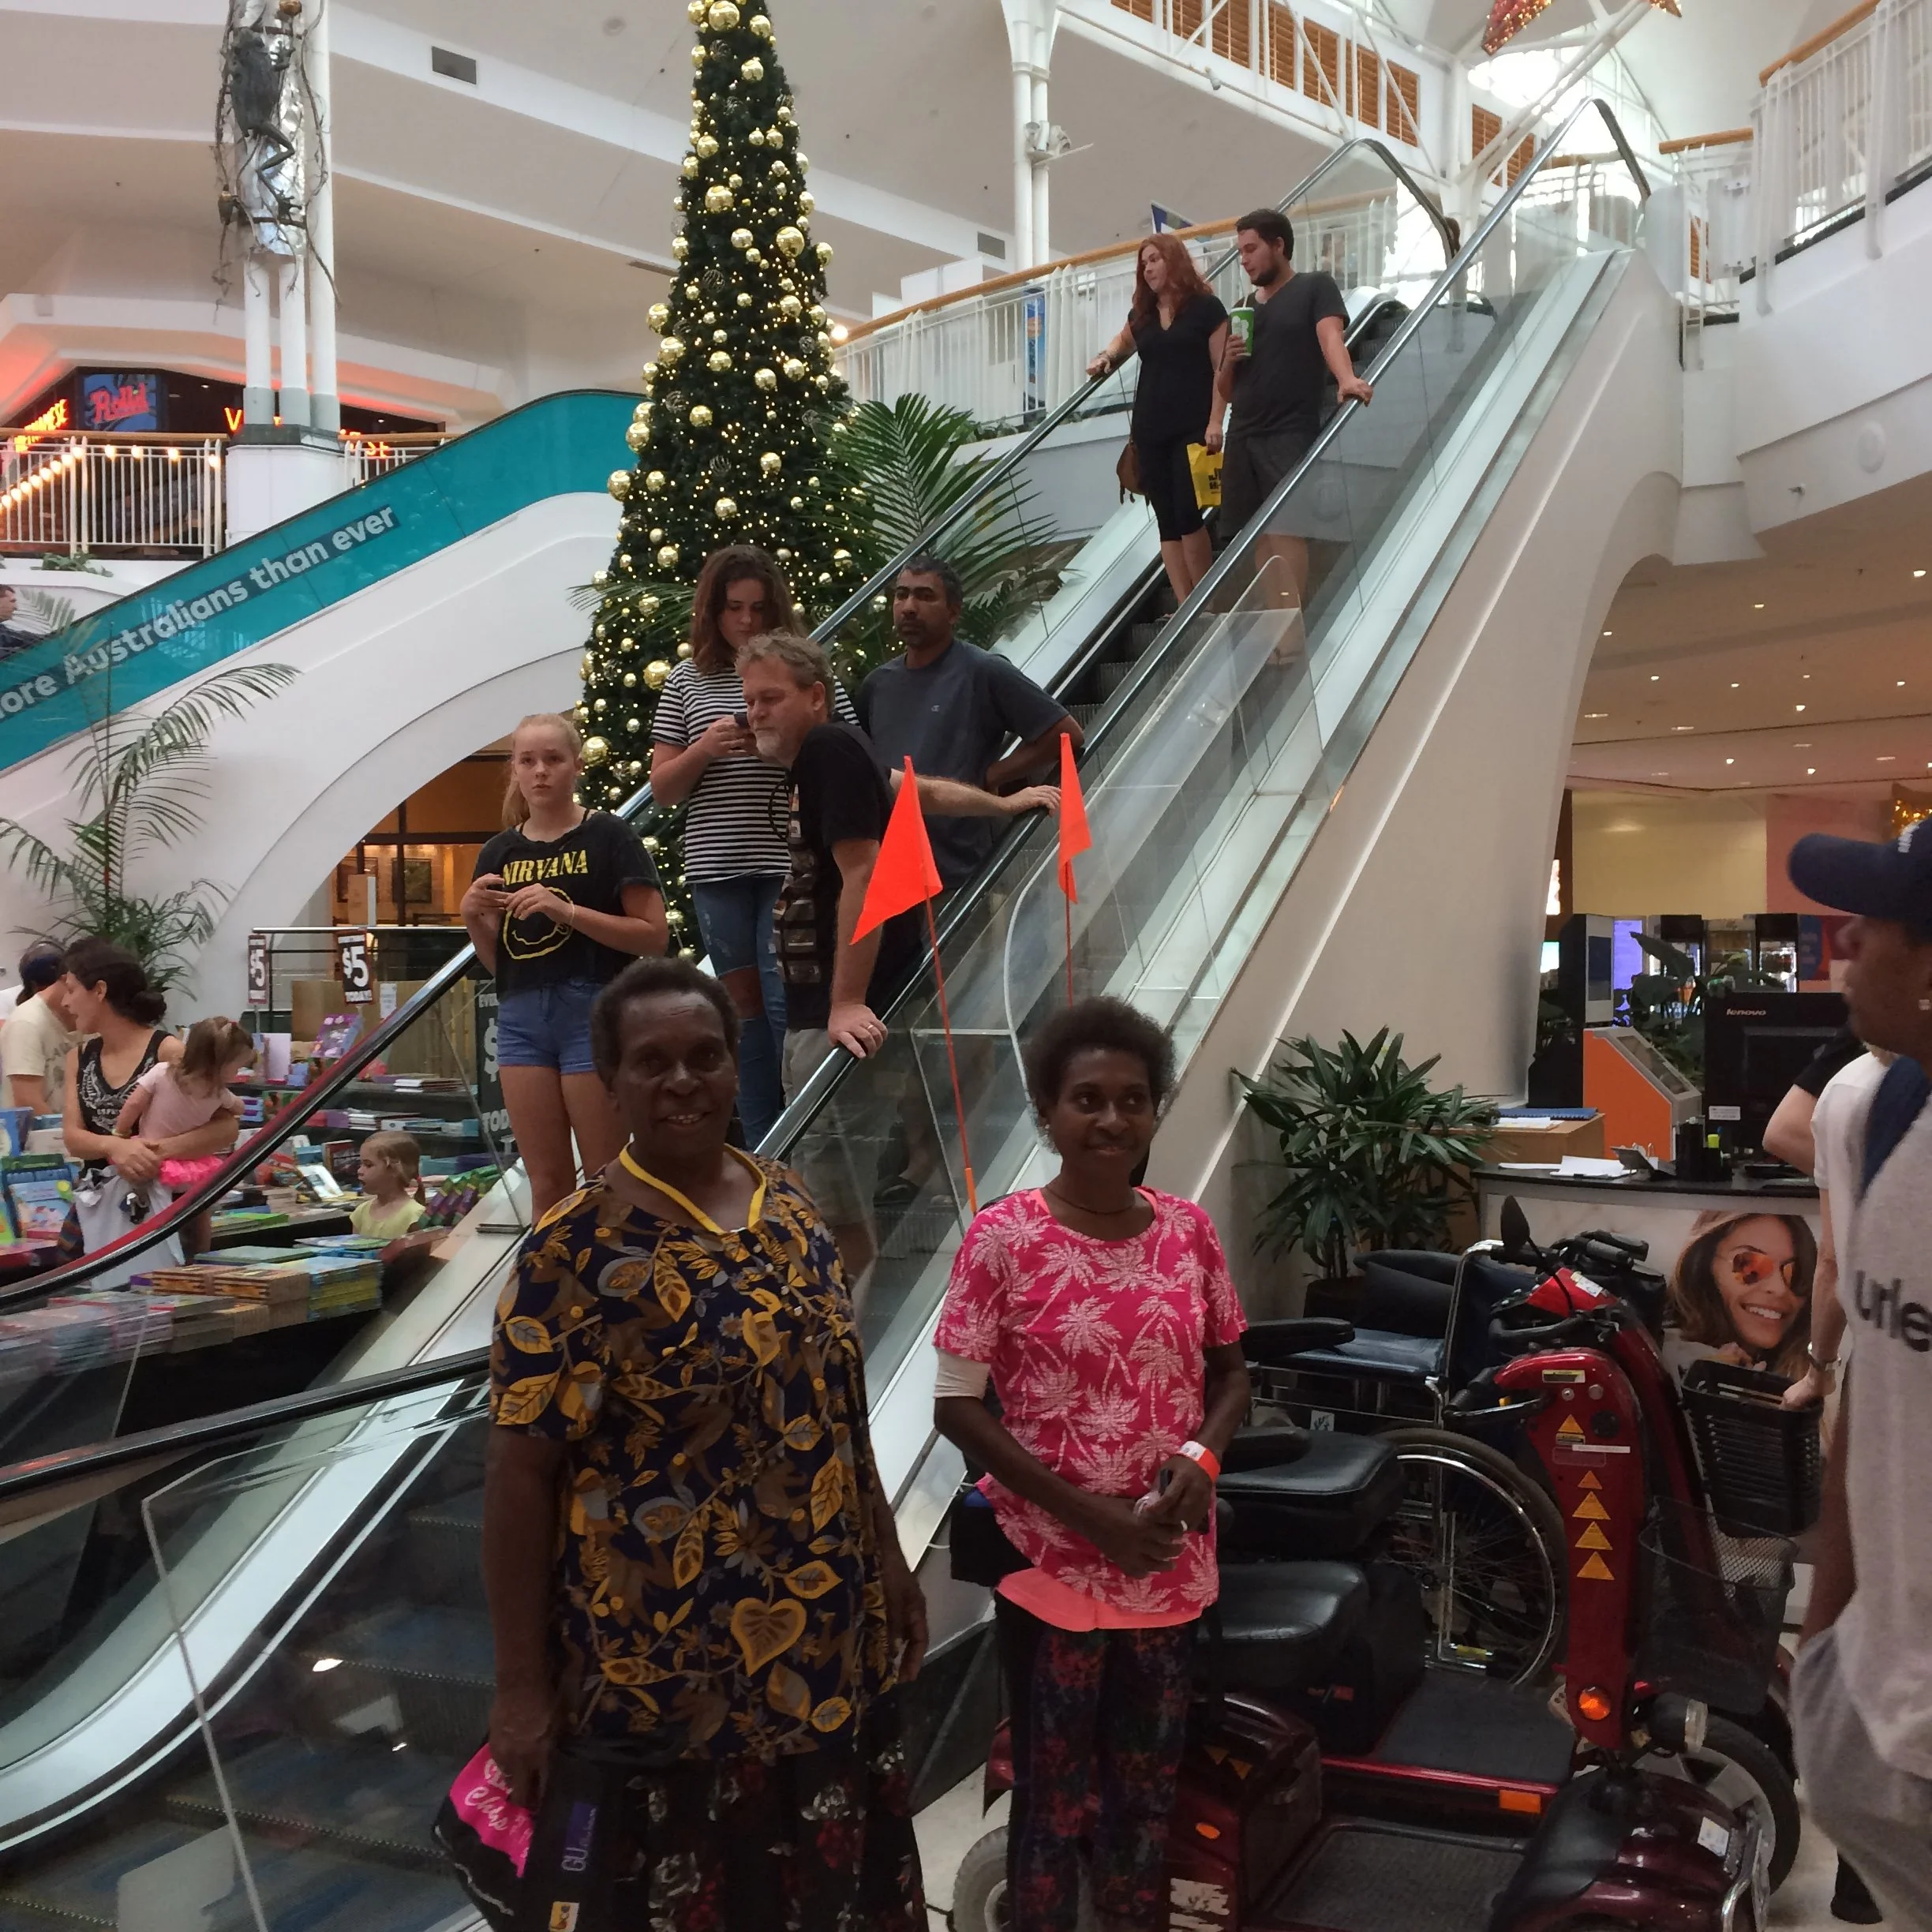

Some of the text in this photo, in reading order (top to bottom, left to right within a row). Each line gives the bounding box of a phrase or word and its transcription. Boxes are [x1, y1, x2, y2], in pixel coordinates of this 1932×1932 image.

[0, 506, 395, 719] ore Australians than ever
[504, 850, 588, 886] NIRVANA
[342, 945, 369, 987] $5
